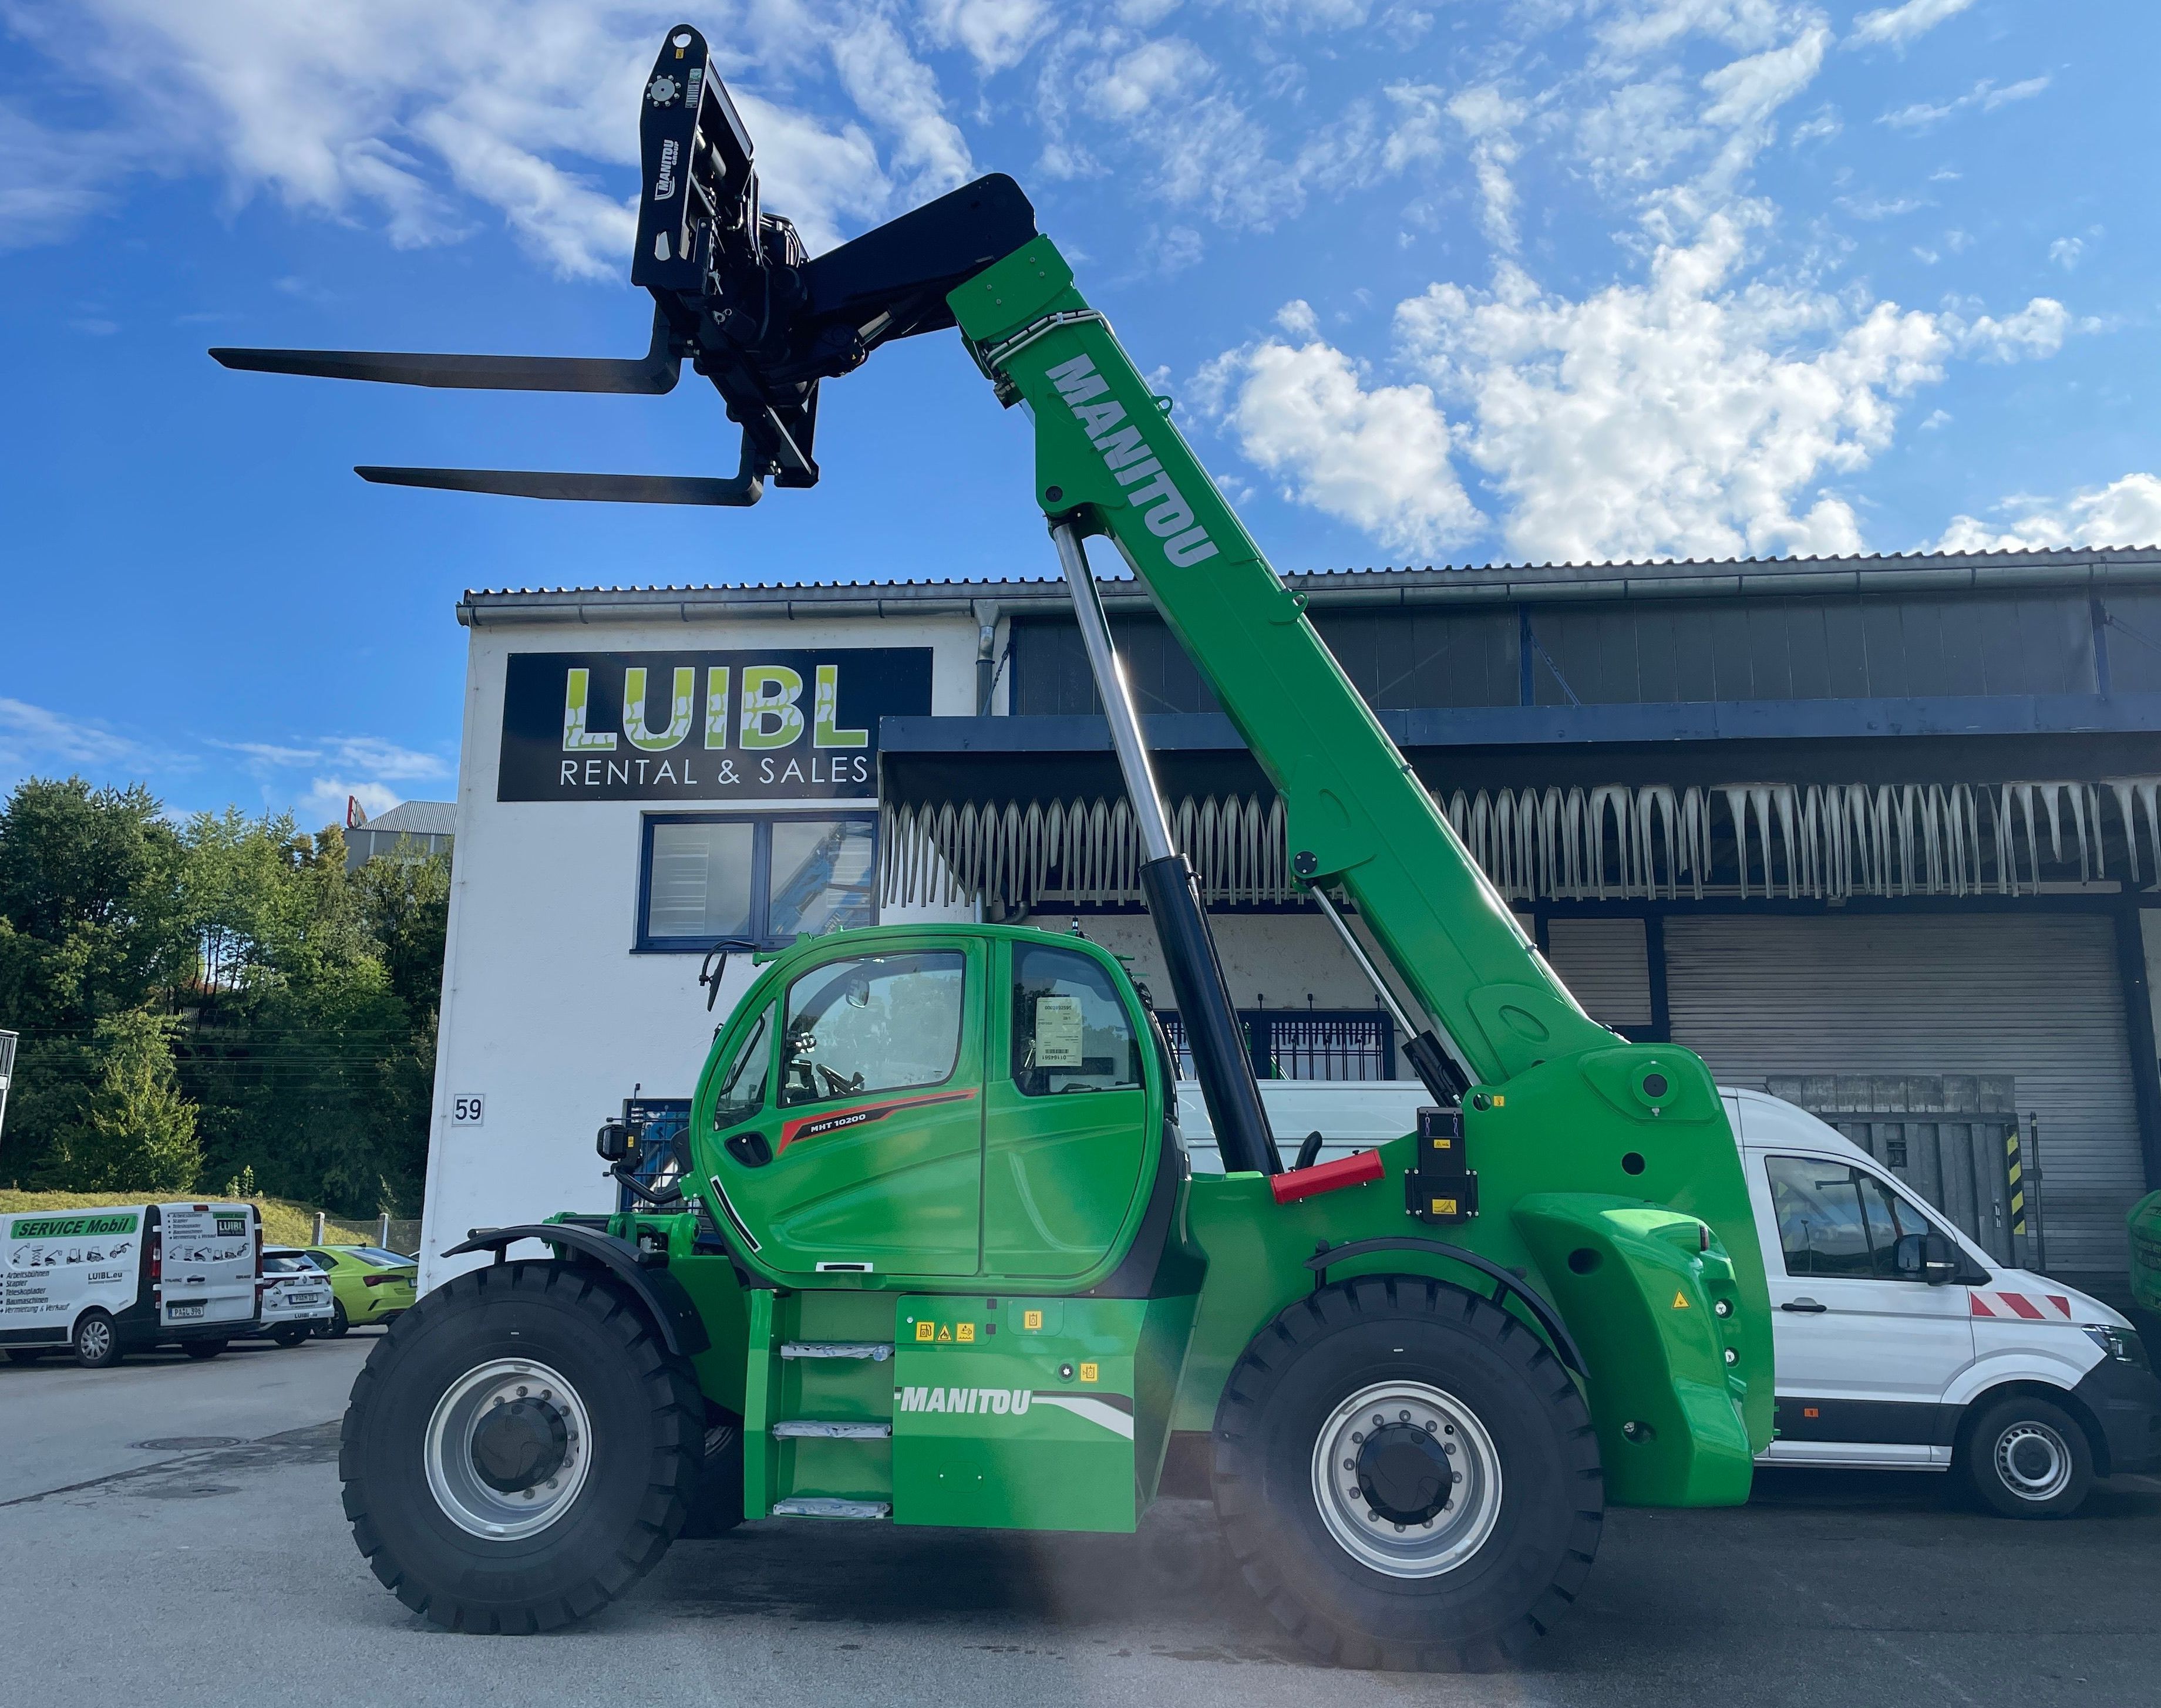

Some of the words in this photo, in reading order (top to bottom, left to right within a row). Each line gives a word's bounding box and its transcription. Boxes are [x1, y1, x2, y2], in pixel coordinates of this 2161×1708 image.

[658, 139, 674, 191] MANITOU
[1045, 353, 1220, 568] MANITOU
[562, 664, 869, 752] LUIBL
[560, 758, 698, 786] RENTAL
[718, 758, 741, 785] &
[759, 755, 869, 784] SALES
[455, 1099, 482, 1120] 59
[810, 1121, 833, 1133] MHT
[834, 1114, 866, 1127] 10200
[18, 1220, 86, 1237] SERVICE
[86, 1218, 130, 1234] Mobil
[88, 1272, 123, 1280] LUIBL.eu
[900, 1386, 1032, 1415] MANITOU
